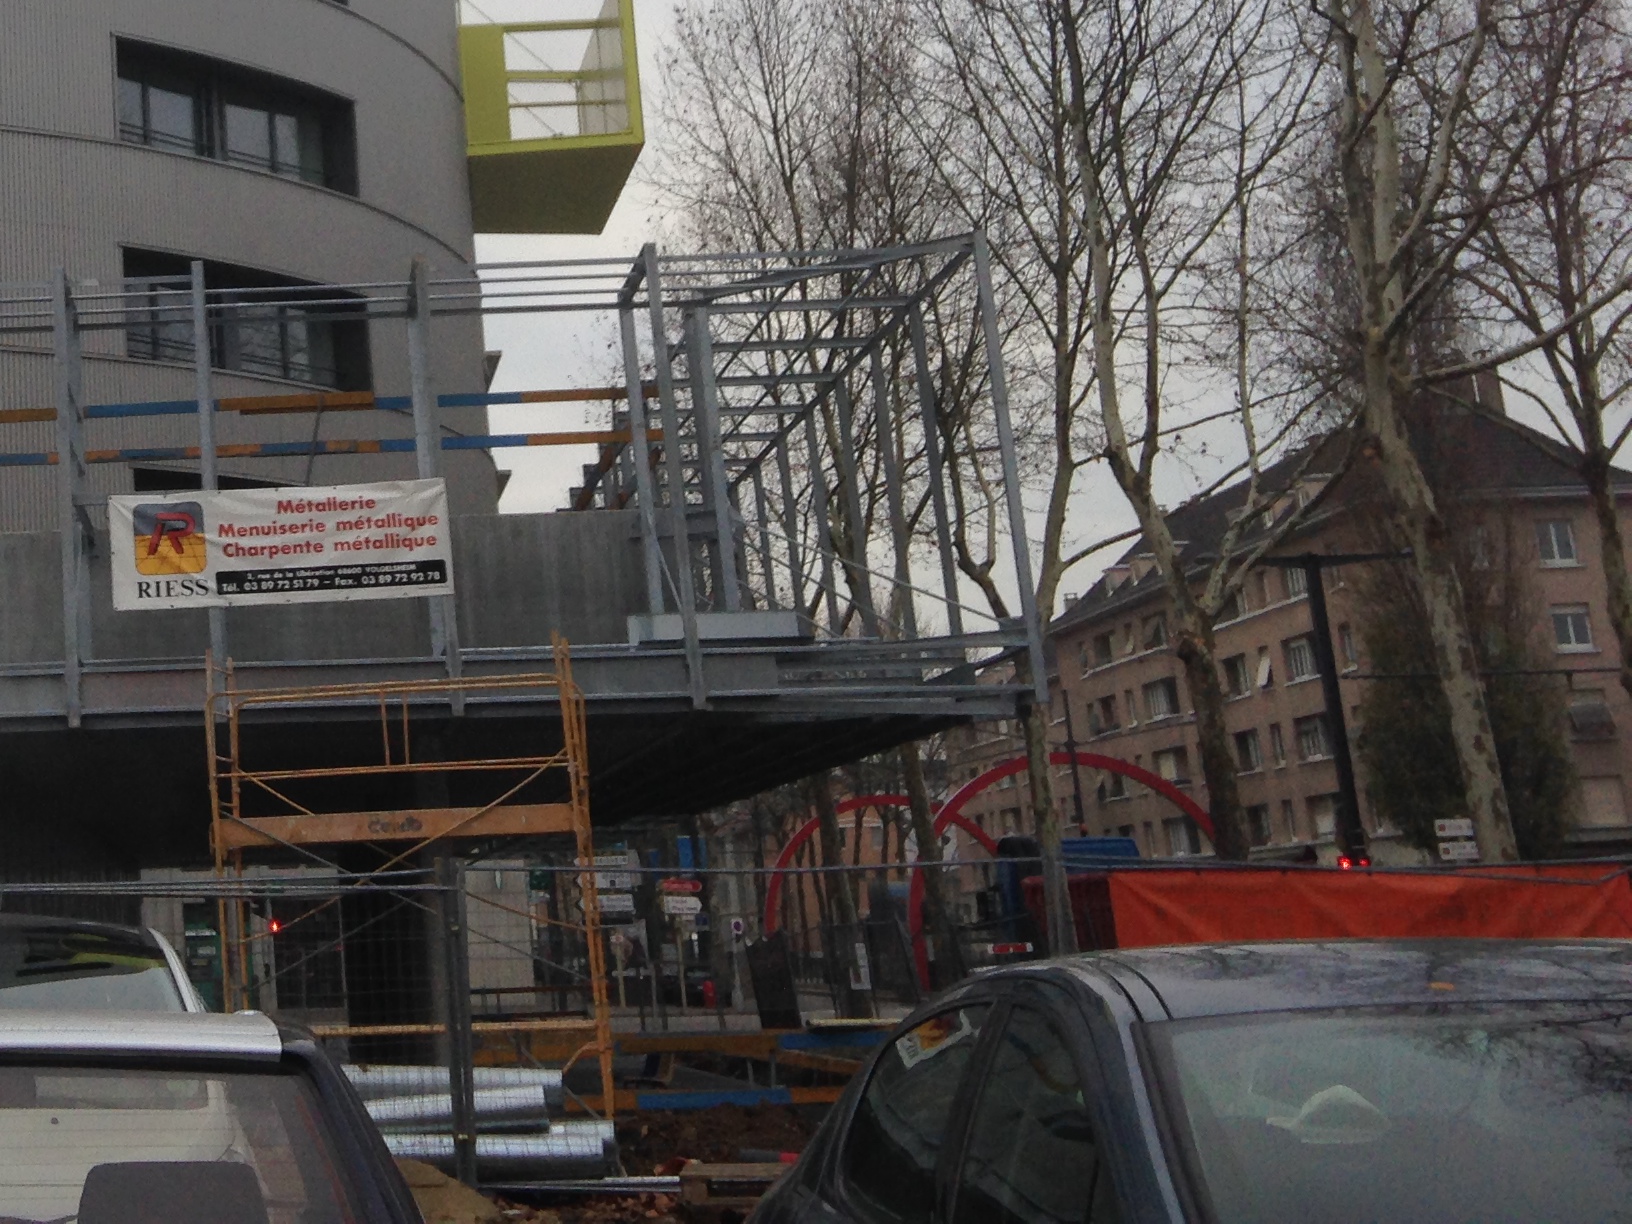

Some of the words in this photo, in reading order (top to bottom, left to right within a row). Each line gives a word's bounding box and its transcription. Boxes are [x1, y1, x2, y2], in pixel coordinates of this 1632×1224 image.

[277, 496, 376, 514] Métallerie
[218, 519, 326, 537] Menuiserie
[336, 512, 438, 532] métallique
[223, 540, 324, 559] Charpente
[334, 533, 437, 551] métallique
[137, 579, 209, 598] RIESS
[222, 582, 240, 592] Tél.
[243, 581, 258, 590] 03
[261, 580, 274, 589] 89
[277, 579, 290, 588] 72
[293, 578, 304, 588] 51
[306, 577, 320, 587] 79
[335, 577, 358, 586] Fax.
[361, 575, 376, 584] 03
[378, 574, 392, 583] 89
[394, 573, 408, 582] 72
[410, 572, 424, 581] 92
[427, 571, 441, 580] 78
